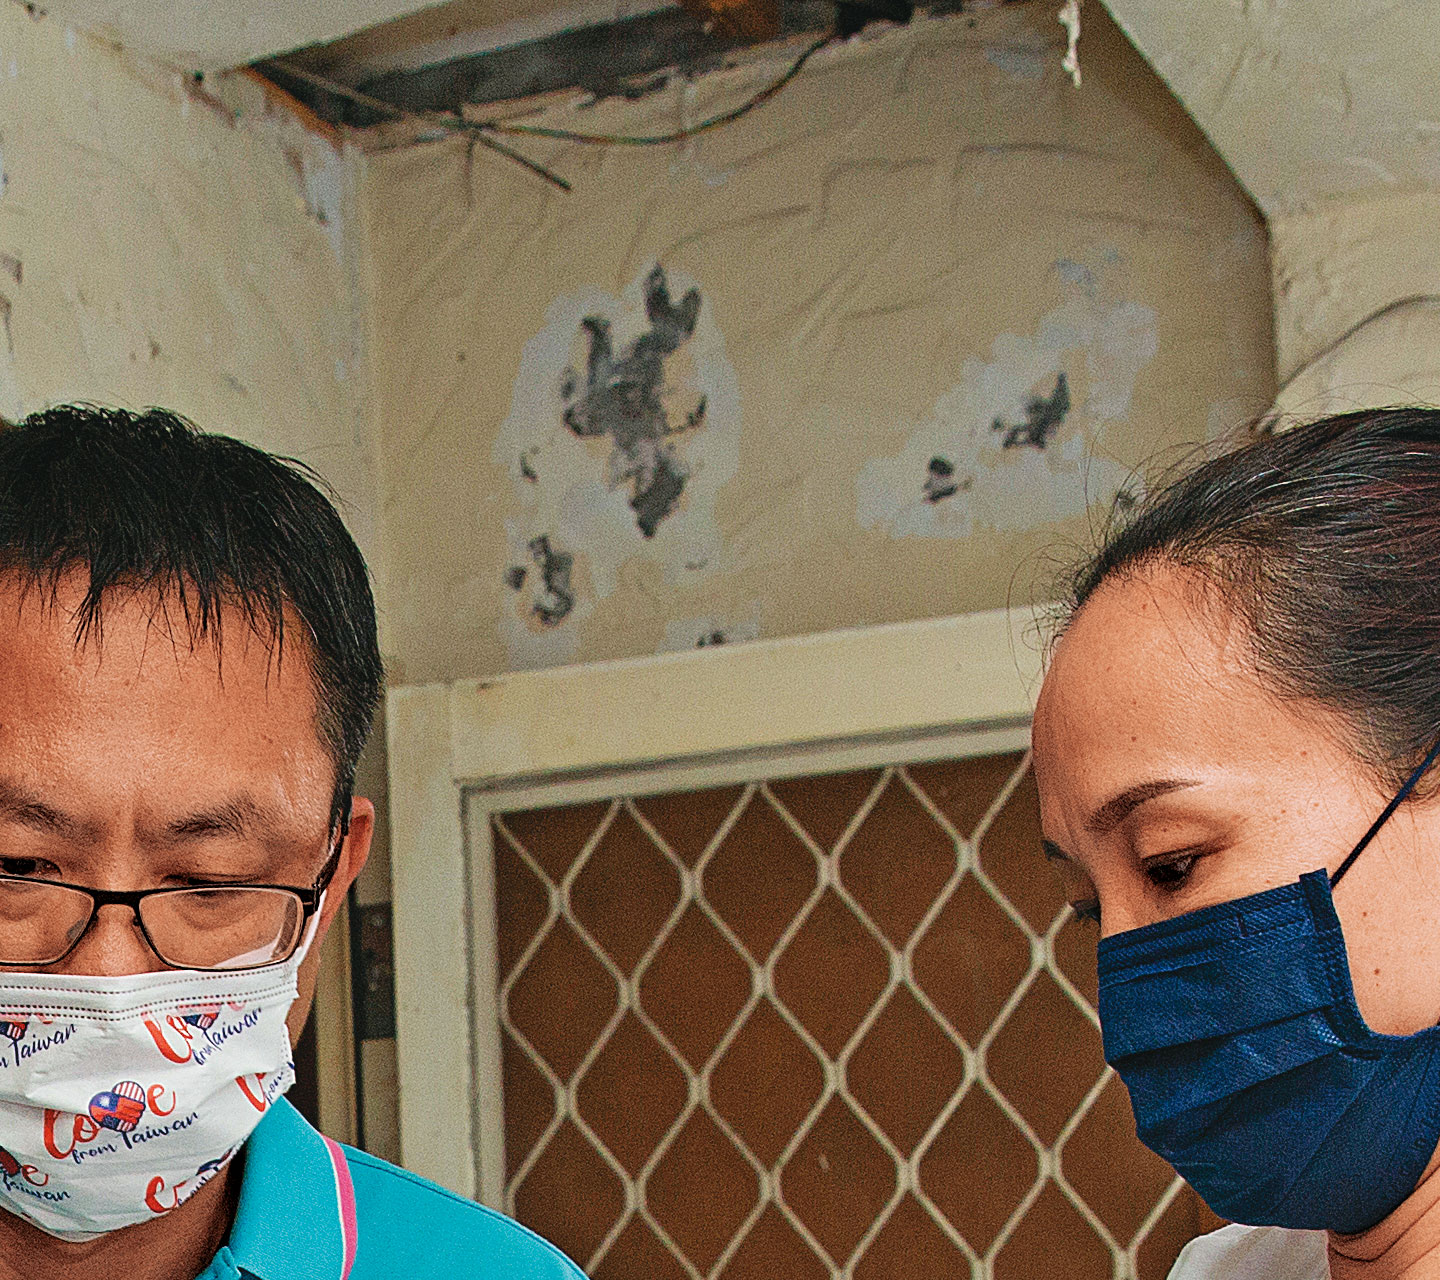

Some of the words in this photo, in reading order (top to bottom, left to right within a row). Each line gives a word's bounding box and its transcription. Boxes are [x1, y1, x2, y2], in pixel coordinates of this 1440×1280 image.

[8, 1023, 77, 1067] Taiwan
[71, 1141, 118, 1165] from
[116, 1111, 199, 1150] Taiwan
